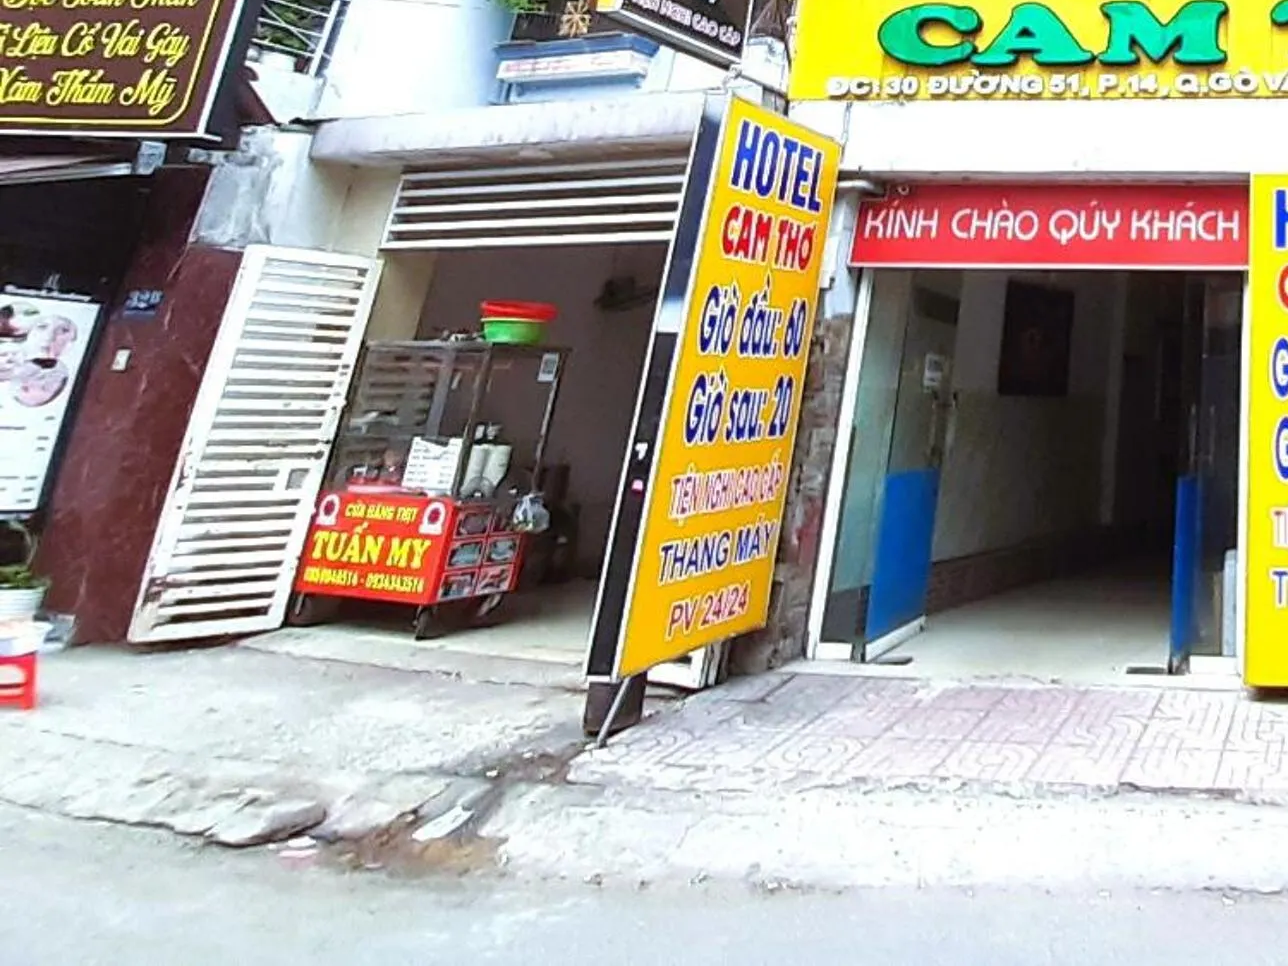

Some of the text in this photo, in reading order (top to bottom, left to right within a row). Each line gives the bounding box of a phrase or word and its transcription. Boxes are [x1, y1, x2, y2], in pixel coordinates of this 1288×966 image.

[101, 19, 145, 58] Vai
[143, 22, 190, 67] Gáy
[692, 13, 719, 37] CAO
[878, 0, 1230, 67] CAM
[120, 68, 177, 116] Mỹ
[731, 119, 824, 212] HOTEL
[721, 205, 817, 271] CAM THƠ
[863, 198, 940, 241] KÍNH
[950, 197, 1039, 241] CHÀO
[1129, 200, 1241, 242] KHÁCH
[783, 296, 807, 357] 60
[769, 373, 794, 439] 20
[668, 463, 700, 525] TIỆN
[311, 521, 385, 565] TUẤN
[657, 515, 779, 586] THANG MÁY
[664, 581, 751, 641] PV 24/24
